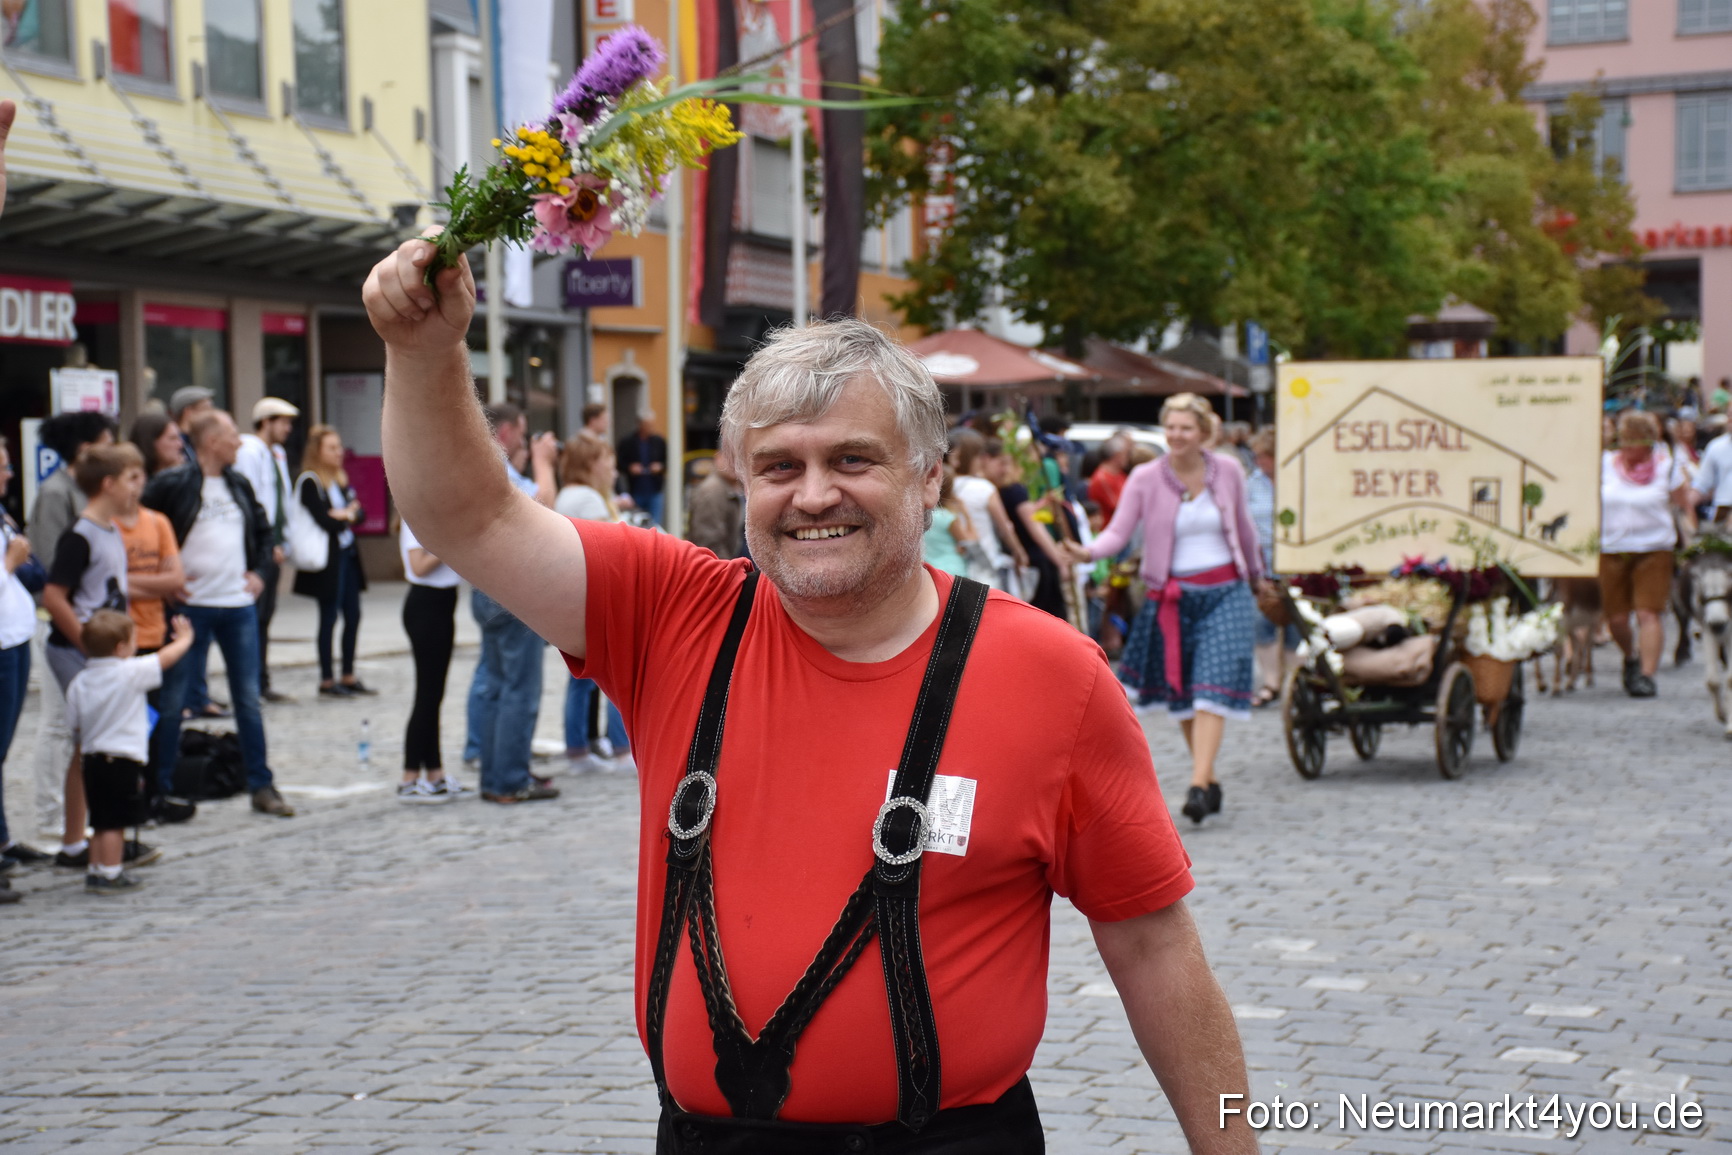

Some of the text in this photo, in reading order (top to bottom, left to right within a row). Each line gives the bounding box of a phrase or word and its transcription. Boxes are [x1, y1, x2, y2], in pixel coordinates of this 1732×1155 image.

[1611, 221, 1732, 253] arkas
[0, 287, 78, 341] DLER
[1334, 420, 1470, 452] ESELSTALL
[1352, 469, 1441, 497] BEYER
[928, 831, 954, 844] RKT
